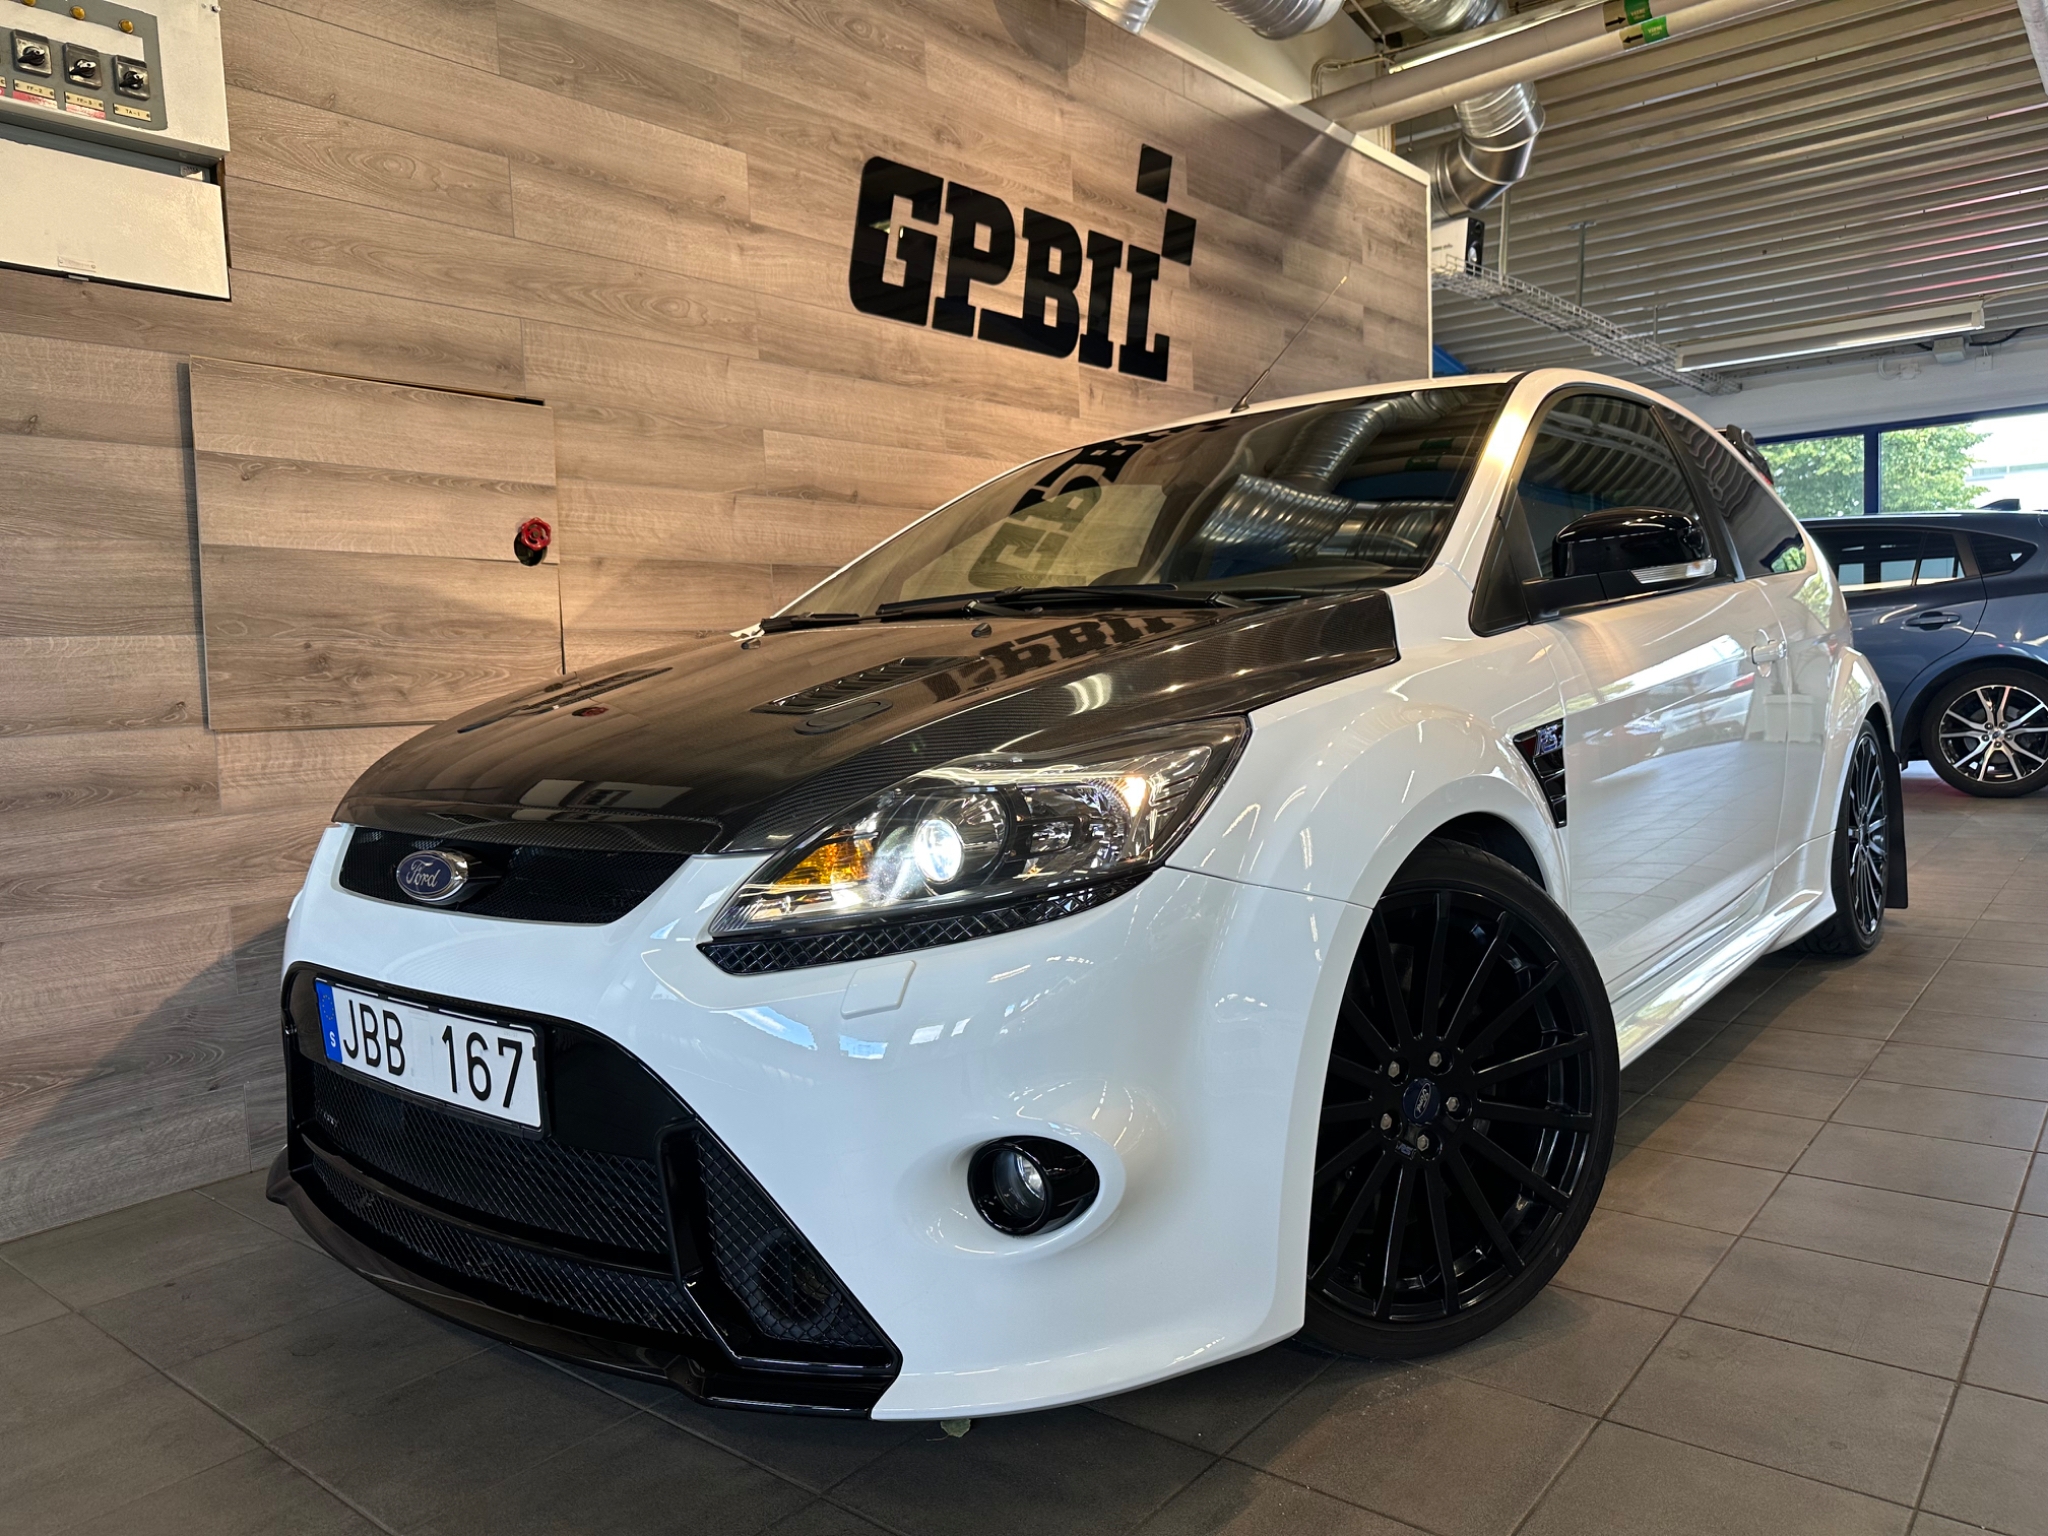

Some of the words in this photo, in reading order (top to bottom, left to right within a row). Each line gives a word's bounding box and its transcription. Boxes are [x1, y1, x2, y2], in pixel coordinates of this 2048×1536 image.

[849, 156, 1170, 382] GPBIL
[405, 859, 441, 888] Ford
[329, 1031, 337, 1048] S
[343, 999, 405, 1077] JBB
[441, 1025, 523, 1109] 167
